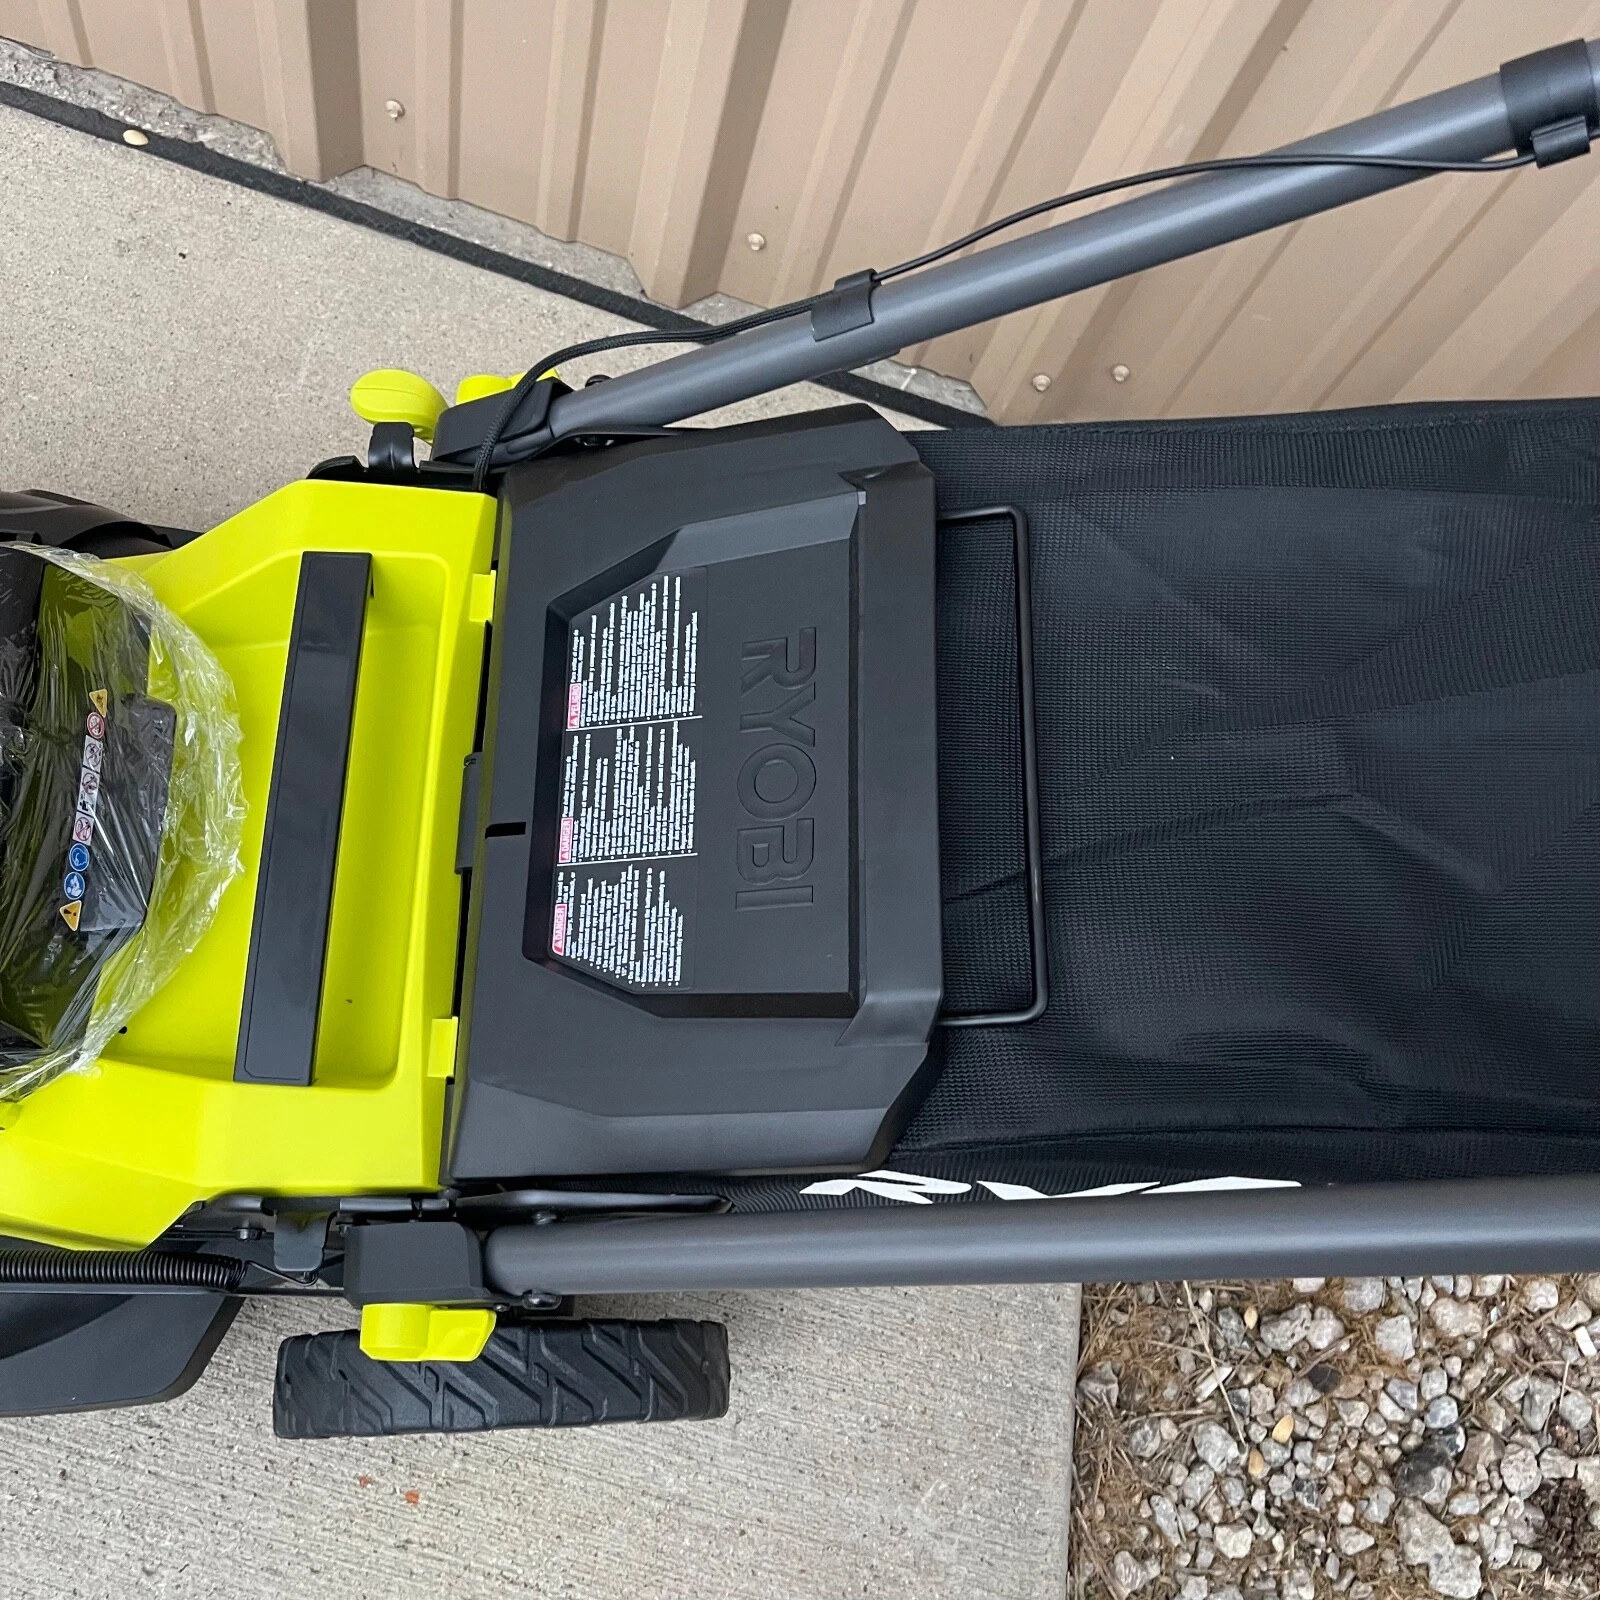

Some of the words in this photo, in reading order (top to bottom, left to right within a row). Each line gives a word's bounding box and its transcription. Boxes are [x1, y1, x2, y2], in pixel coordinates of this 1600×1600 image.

[571, 686, 580, 716] PELIGRO
[735, 627, 816, 911] RYOBI
[562, 820, 570, 851] DANGER
[555, 907, 564, 939] DANGER
